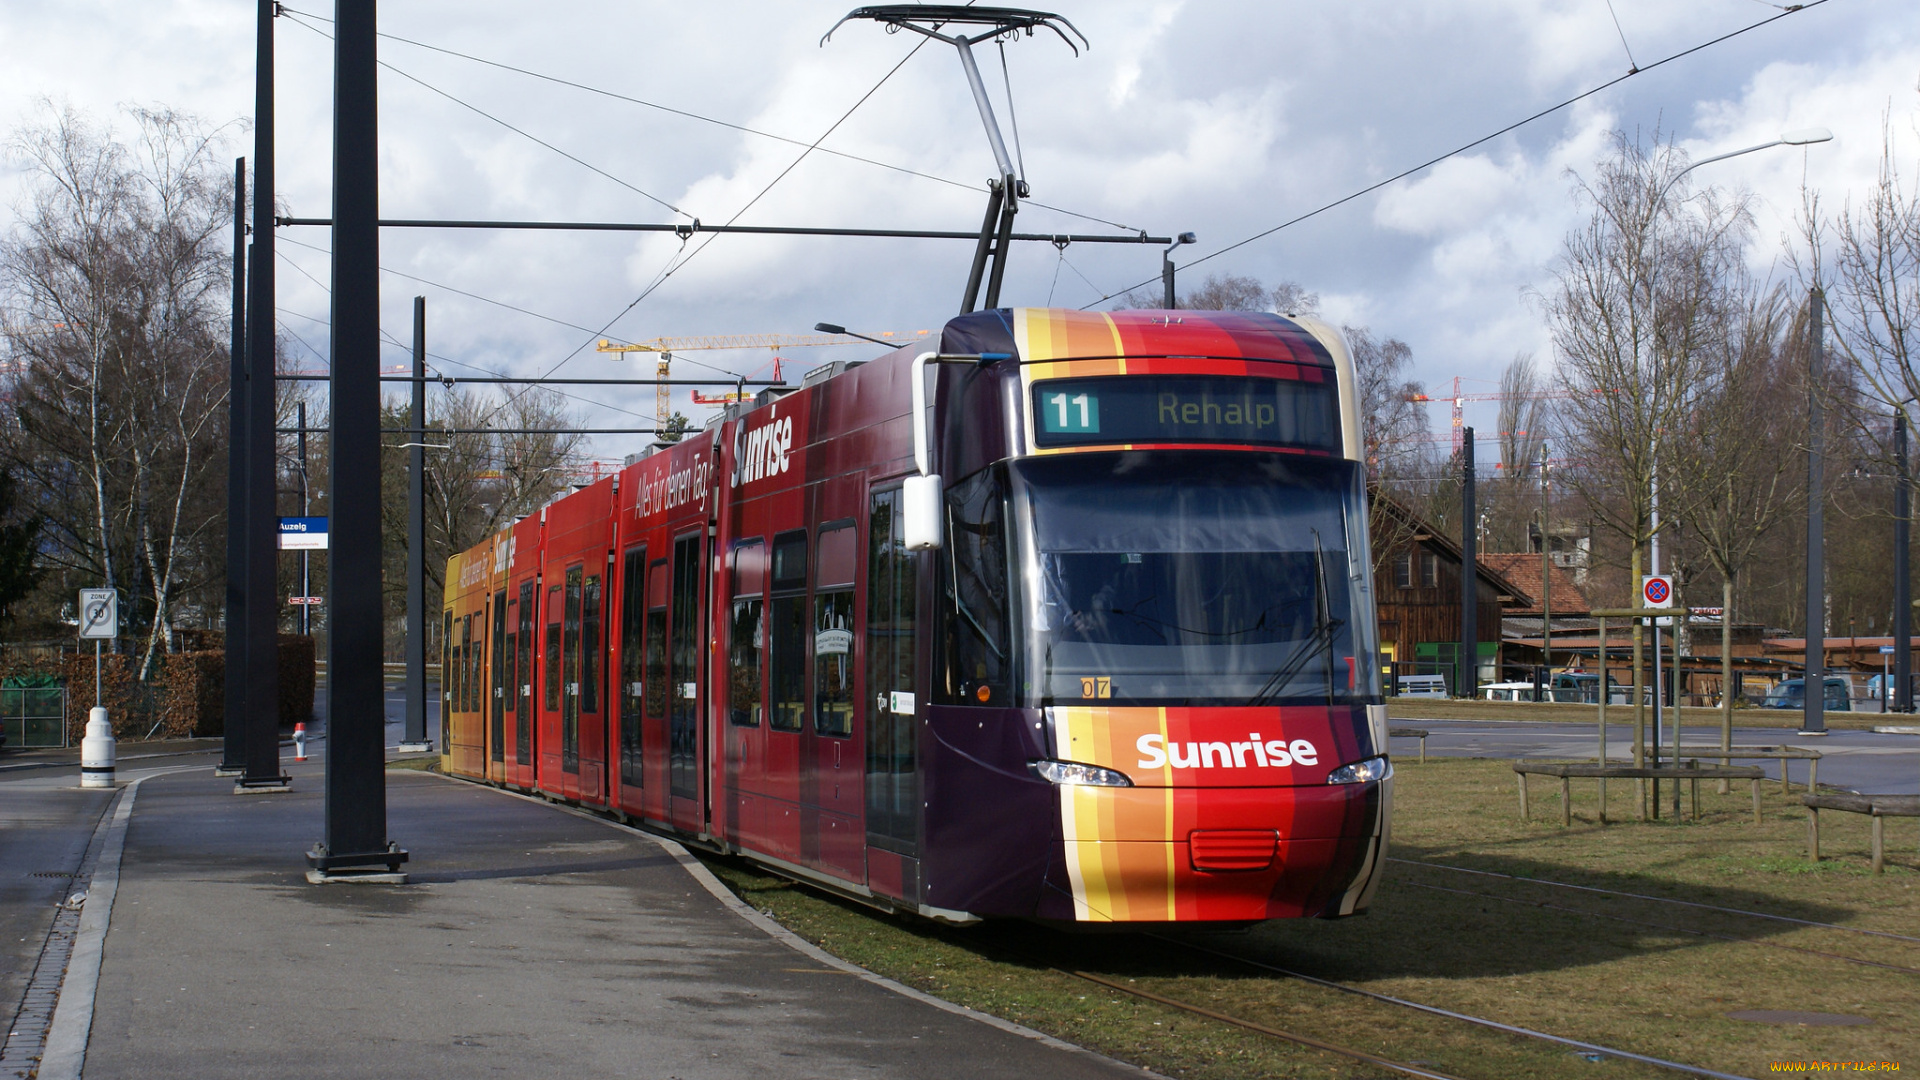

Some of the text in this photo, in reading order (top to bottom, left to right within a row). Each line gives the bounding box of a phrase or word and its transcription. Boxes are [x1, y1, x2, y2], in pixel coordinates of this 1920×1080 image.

[1050, 391, 1276, 429] 11 Rehalp
[731, 404, 793, 489] Sunrise
[634, 453, 709, 520] Alles für deinen Tag.
[93, 608, 104, 619] 30
[1136, 732, 1319, 770] Sunrise
